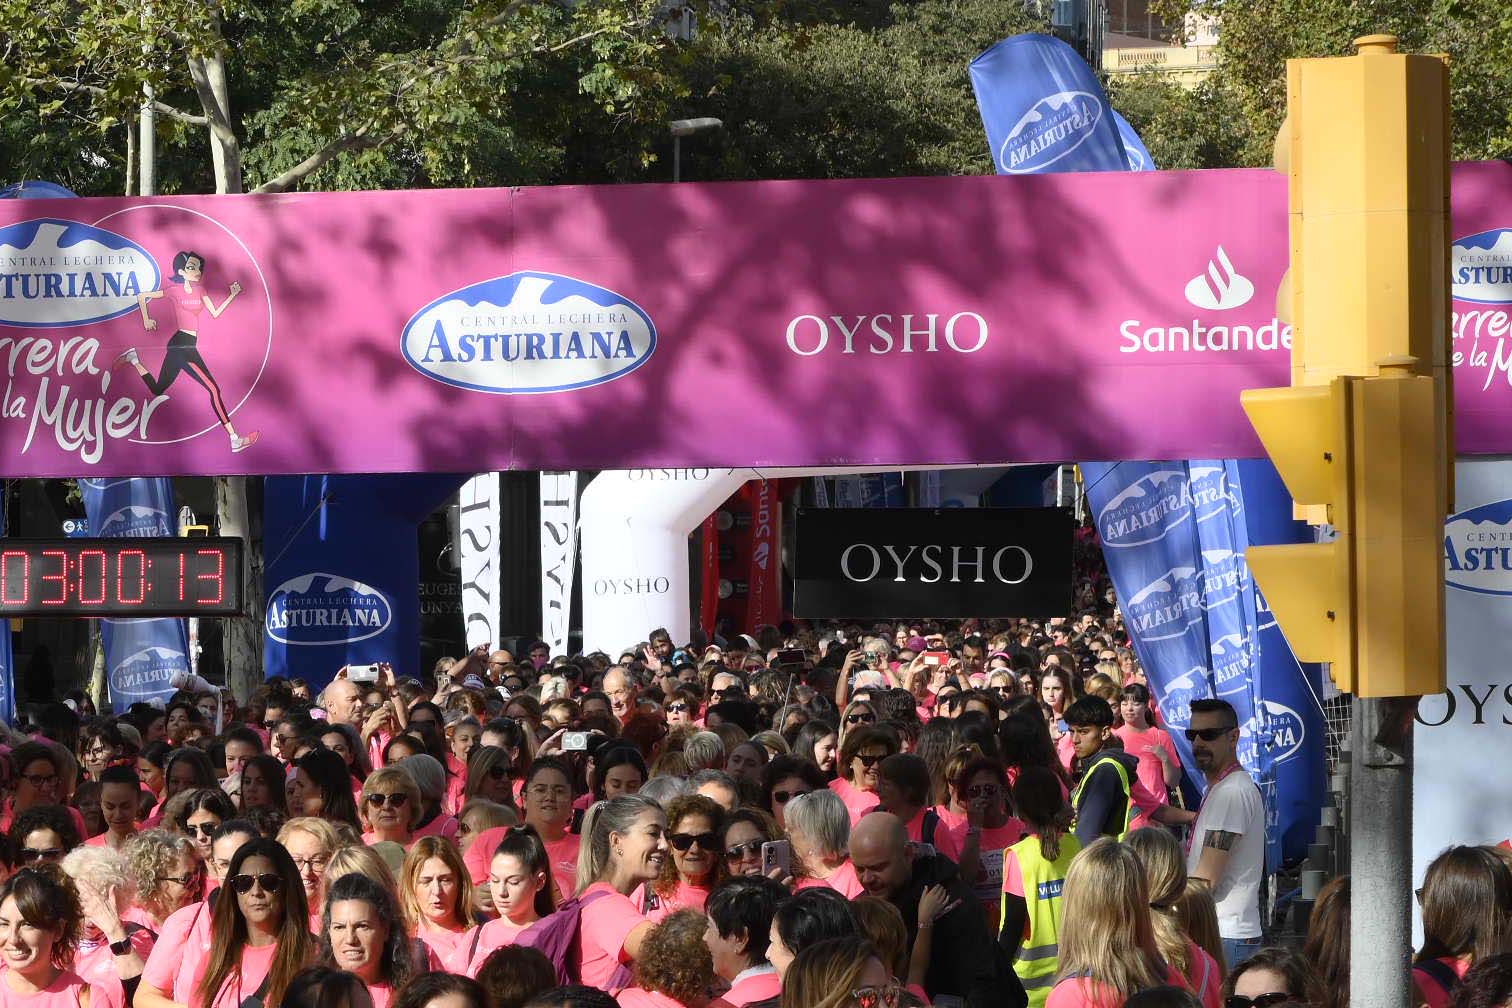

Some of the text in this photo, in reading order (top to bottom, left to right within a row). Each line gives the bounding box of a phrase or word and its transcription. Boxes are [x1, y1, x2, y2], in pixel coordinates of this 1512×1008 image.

[63, 255, 136, 266] LECHERA
[460, 312, 628, 327] CENTRAL LECHERA
[785, 311, 989, 356] OYSHO
[1119, 319, 1294, 353] Santande
[421, 319, 636, 364] ASTURIANA
[1470, 338, 1487, 367] la
[2, 380, 27, 418] la
[21, 370, 171, 464] Mujer
[1, 549, 224, 604] 03:00:13
[841, 544, 1033, 584] OYSHO
[594, 576, 670, 595] OYSHO
[269, 608, 381, 630] ASTURIANA
